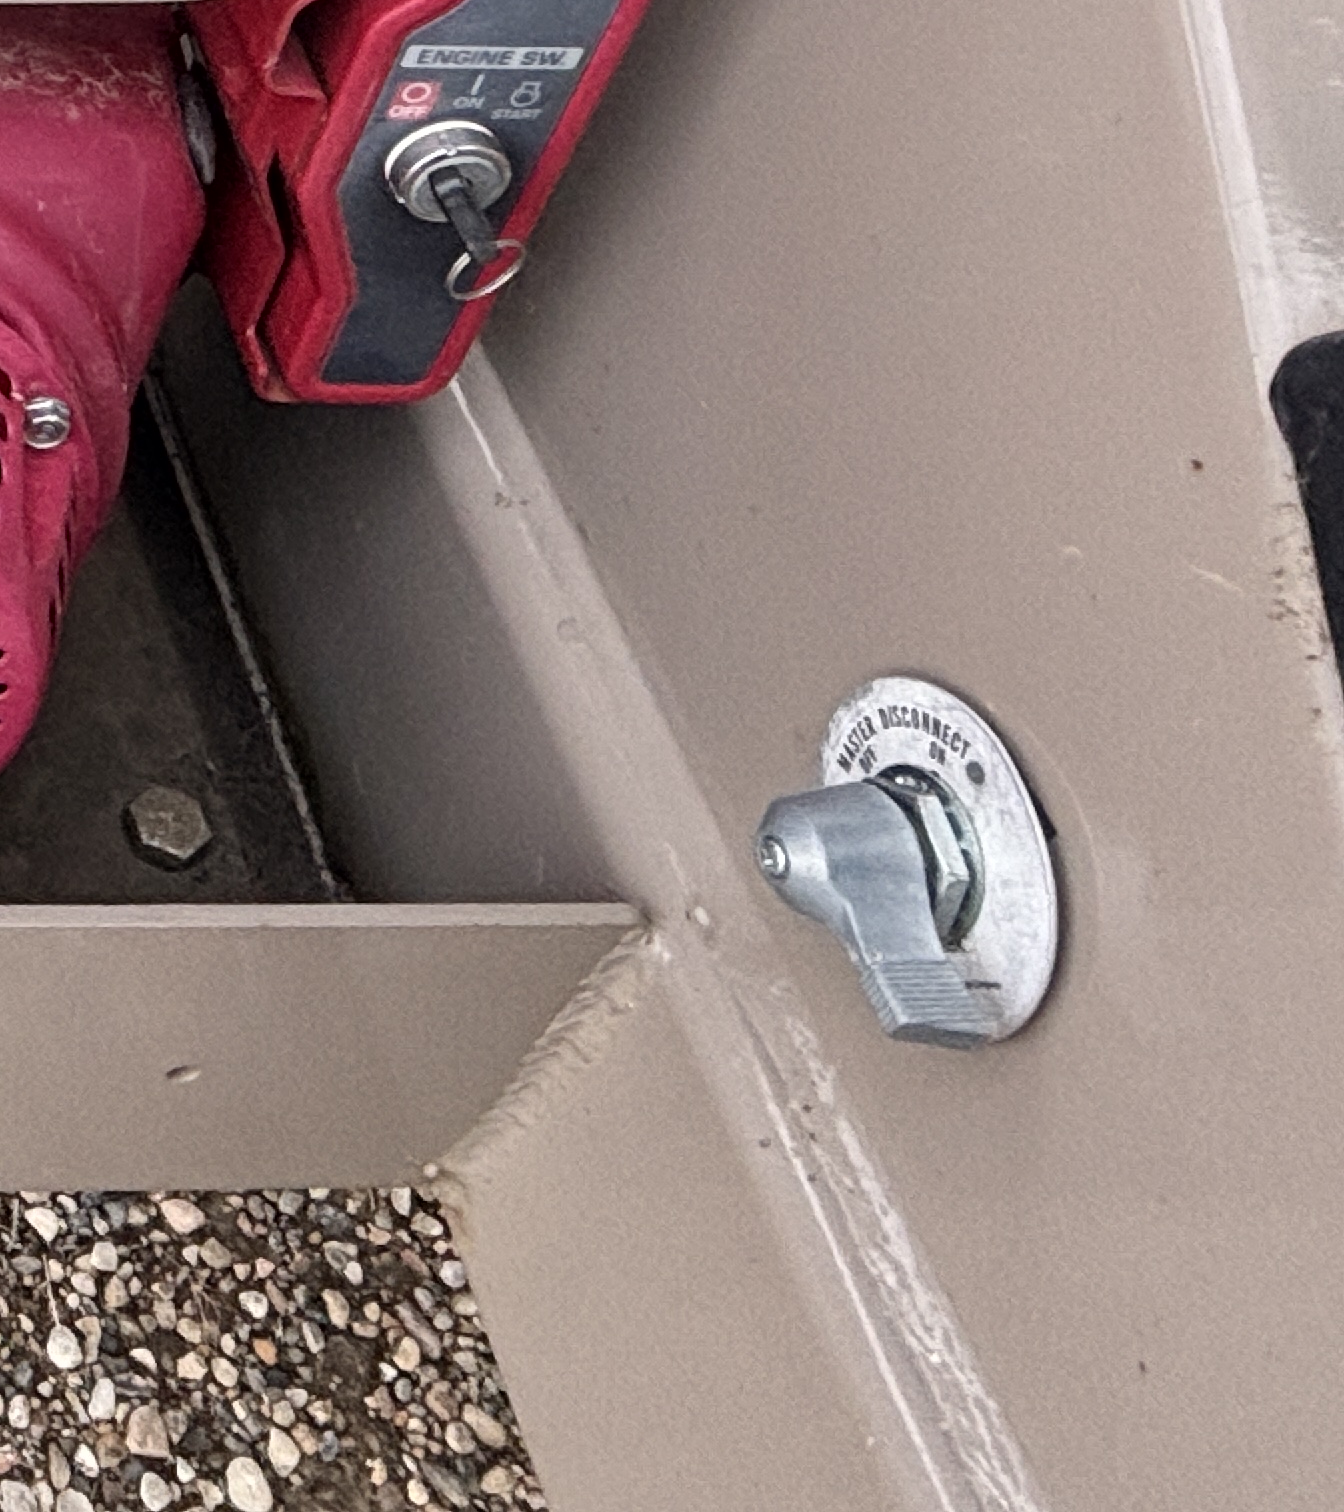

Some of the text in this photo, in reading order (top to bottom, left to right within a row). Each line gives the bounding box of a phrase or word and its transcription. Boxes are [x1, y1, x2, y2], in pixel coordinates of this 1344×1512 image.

[416, 48, 516, 66] ENGINE
[387, 96, 543, 120] OFF ON START
[836, 704, 972, 774] MASTER DISCONNECT
[858, 740, 946, 774] OFF ON
